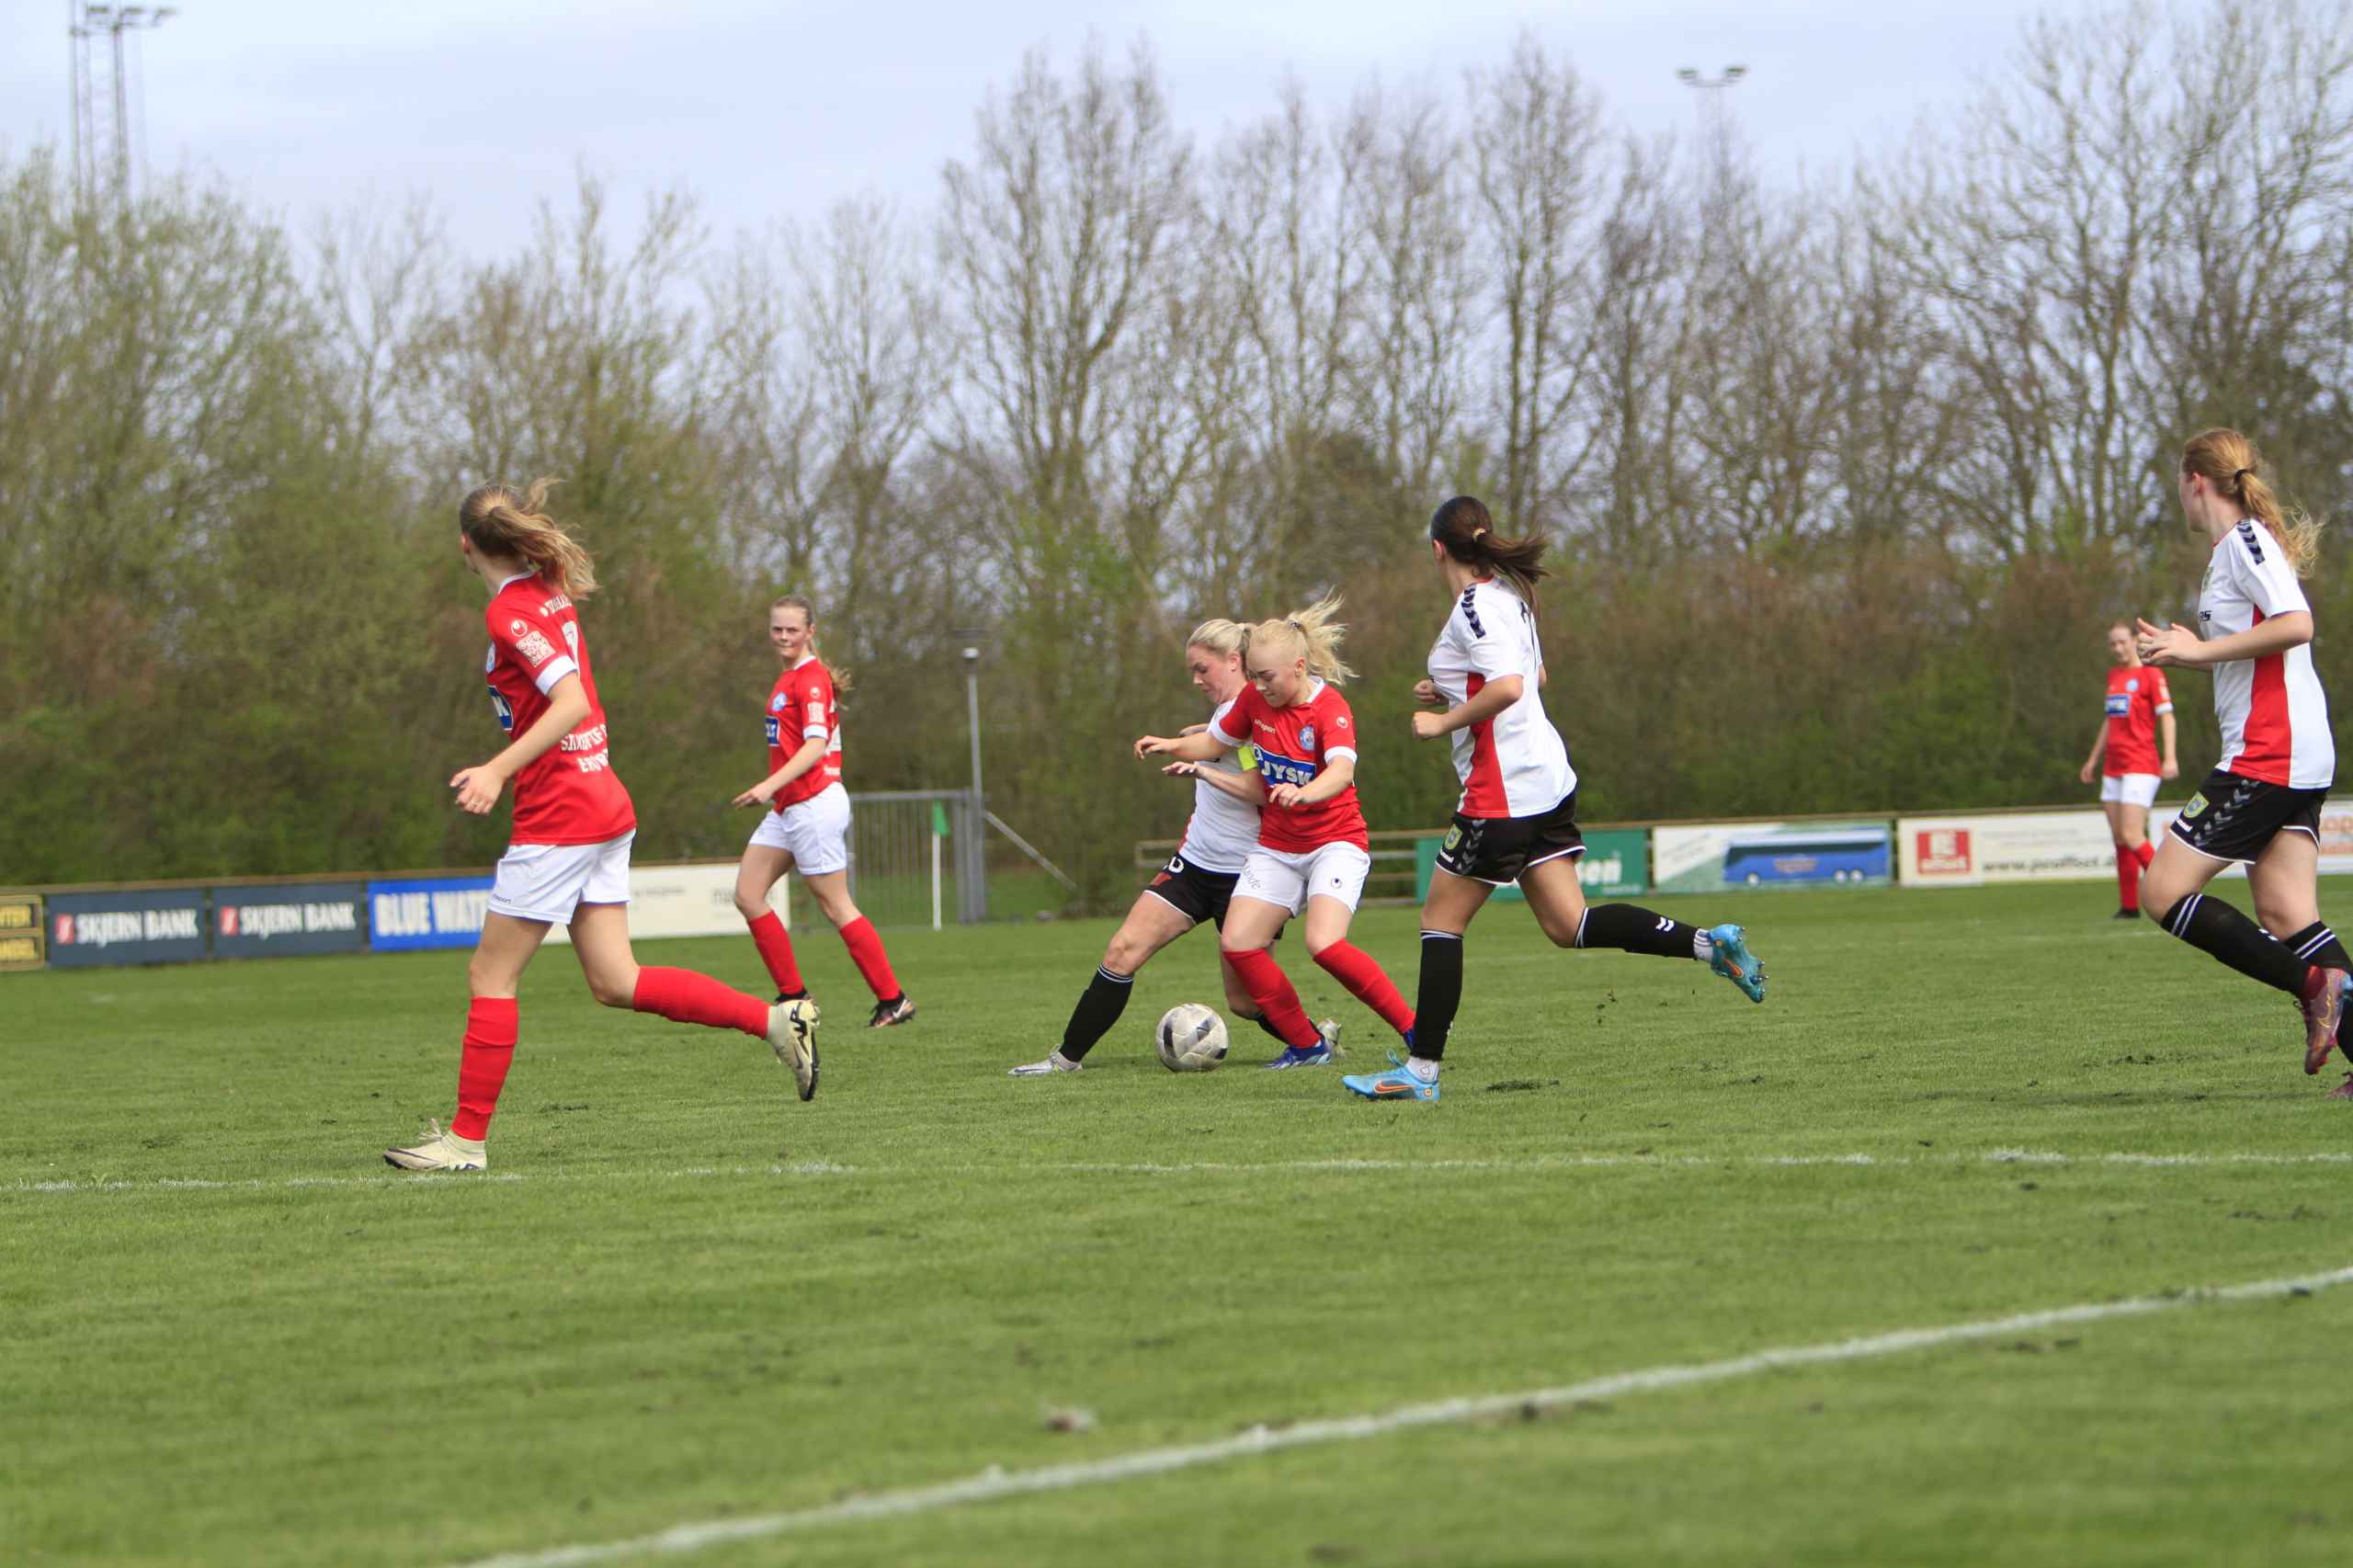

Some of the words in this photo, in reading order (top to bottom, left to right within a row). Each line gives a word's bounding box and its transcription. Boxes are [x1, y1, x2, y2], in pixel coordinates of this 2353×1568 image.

[1261, 761, 1313, 785] JYSK
[143, 909, 199, 940] BANK
[304, 903, 356, 932] BANK
[374, 893, 430, 936] BLUE
